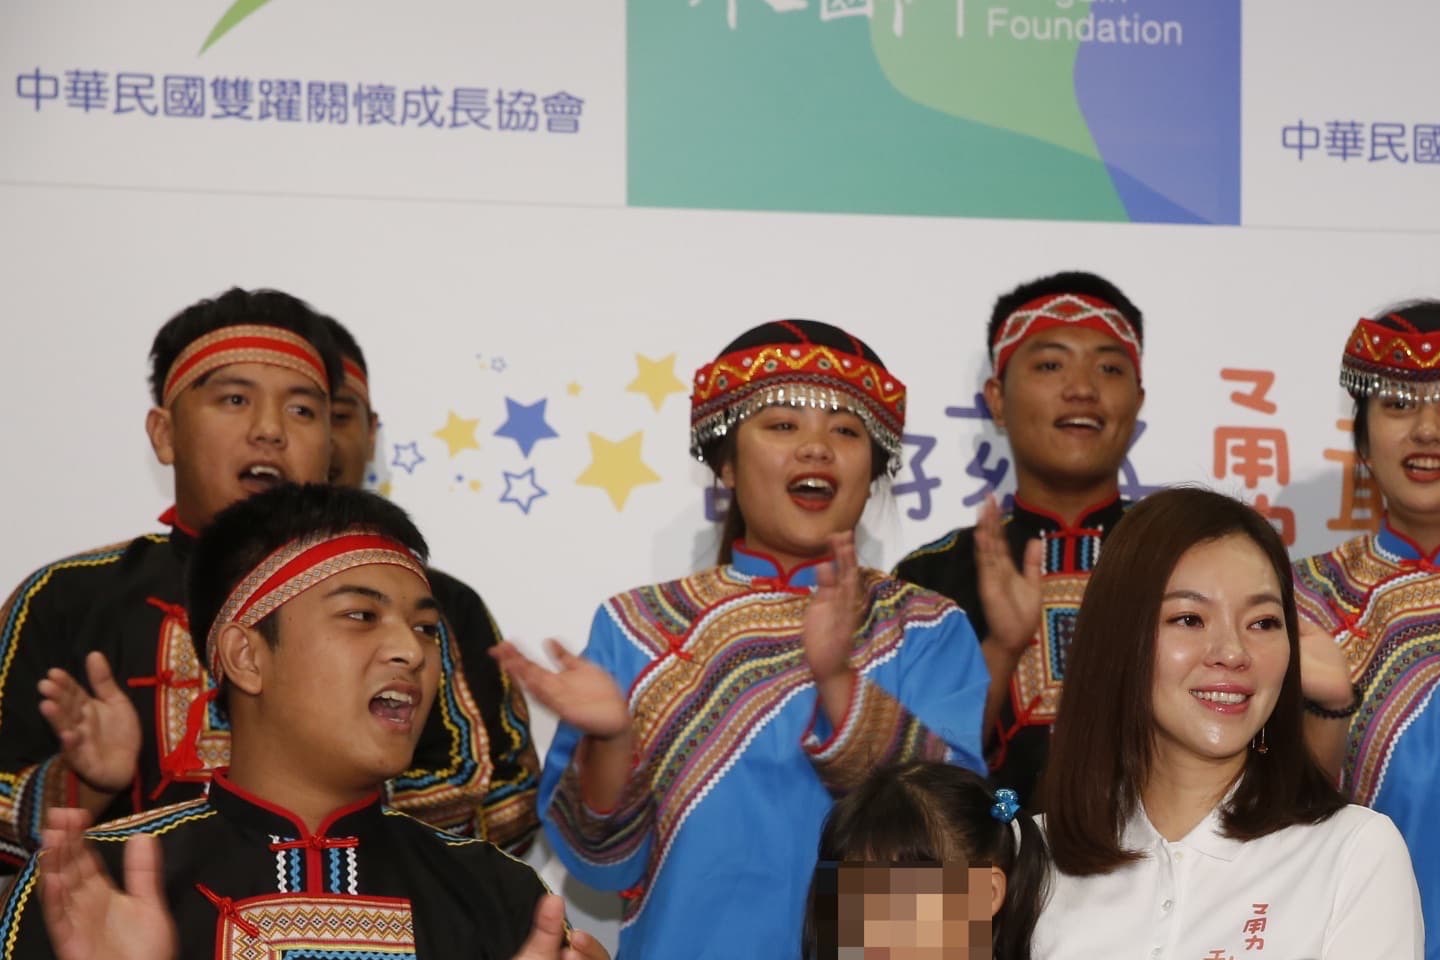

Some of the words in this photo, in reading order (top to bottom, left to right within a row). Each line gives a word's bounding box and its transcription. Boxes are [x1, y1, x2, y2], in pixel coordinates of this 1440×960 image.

[987, 8, 1183, 45] Foundation
[16, 67, 586, 134] 中華民國雙躍關懷成長協會
